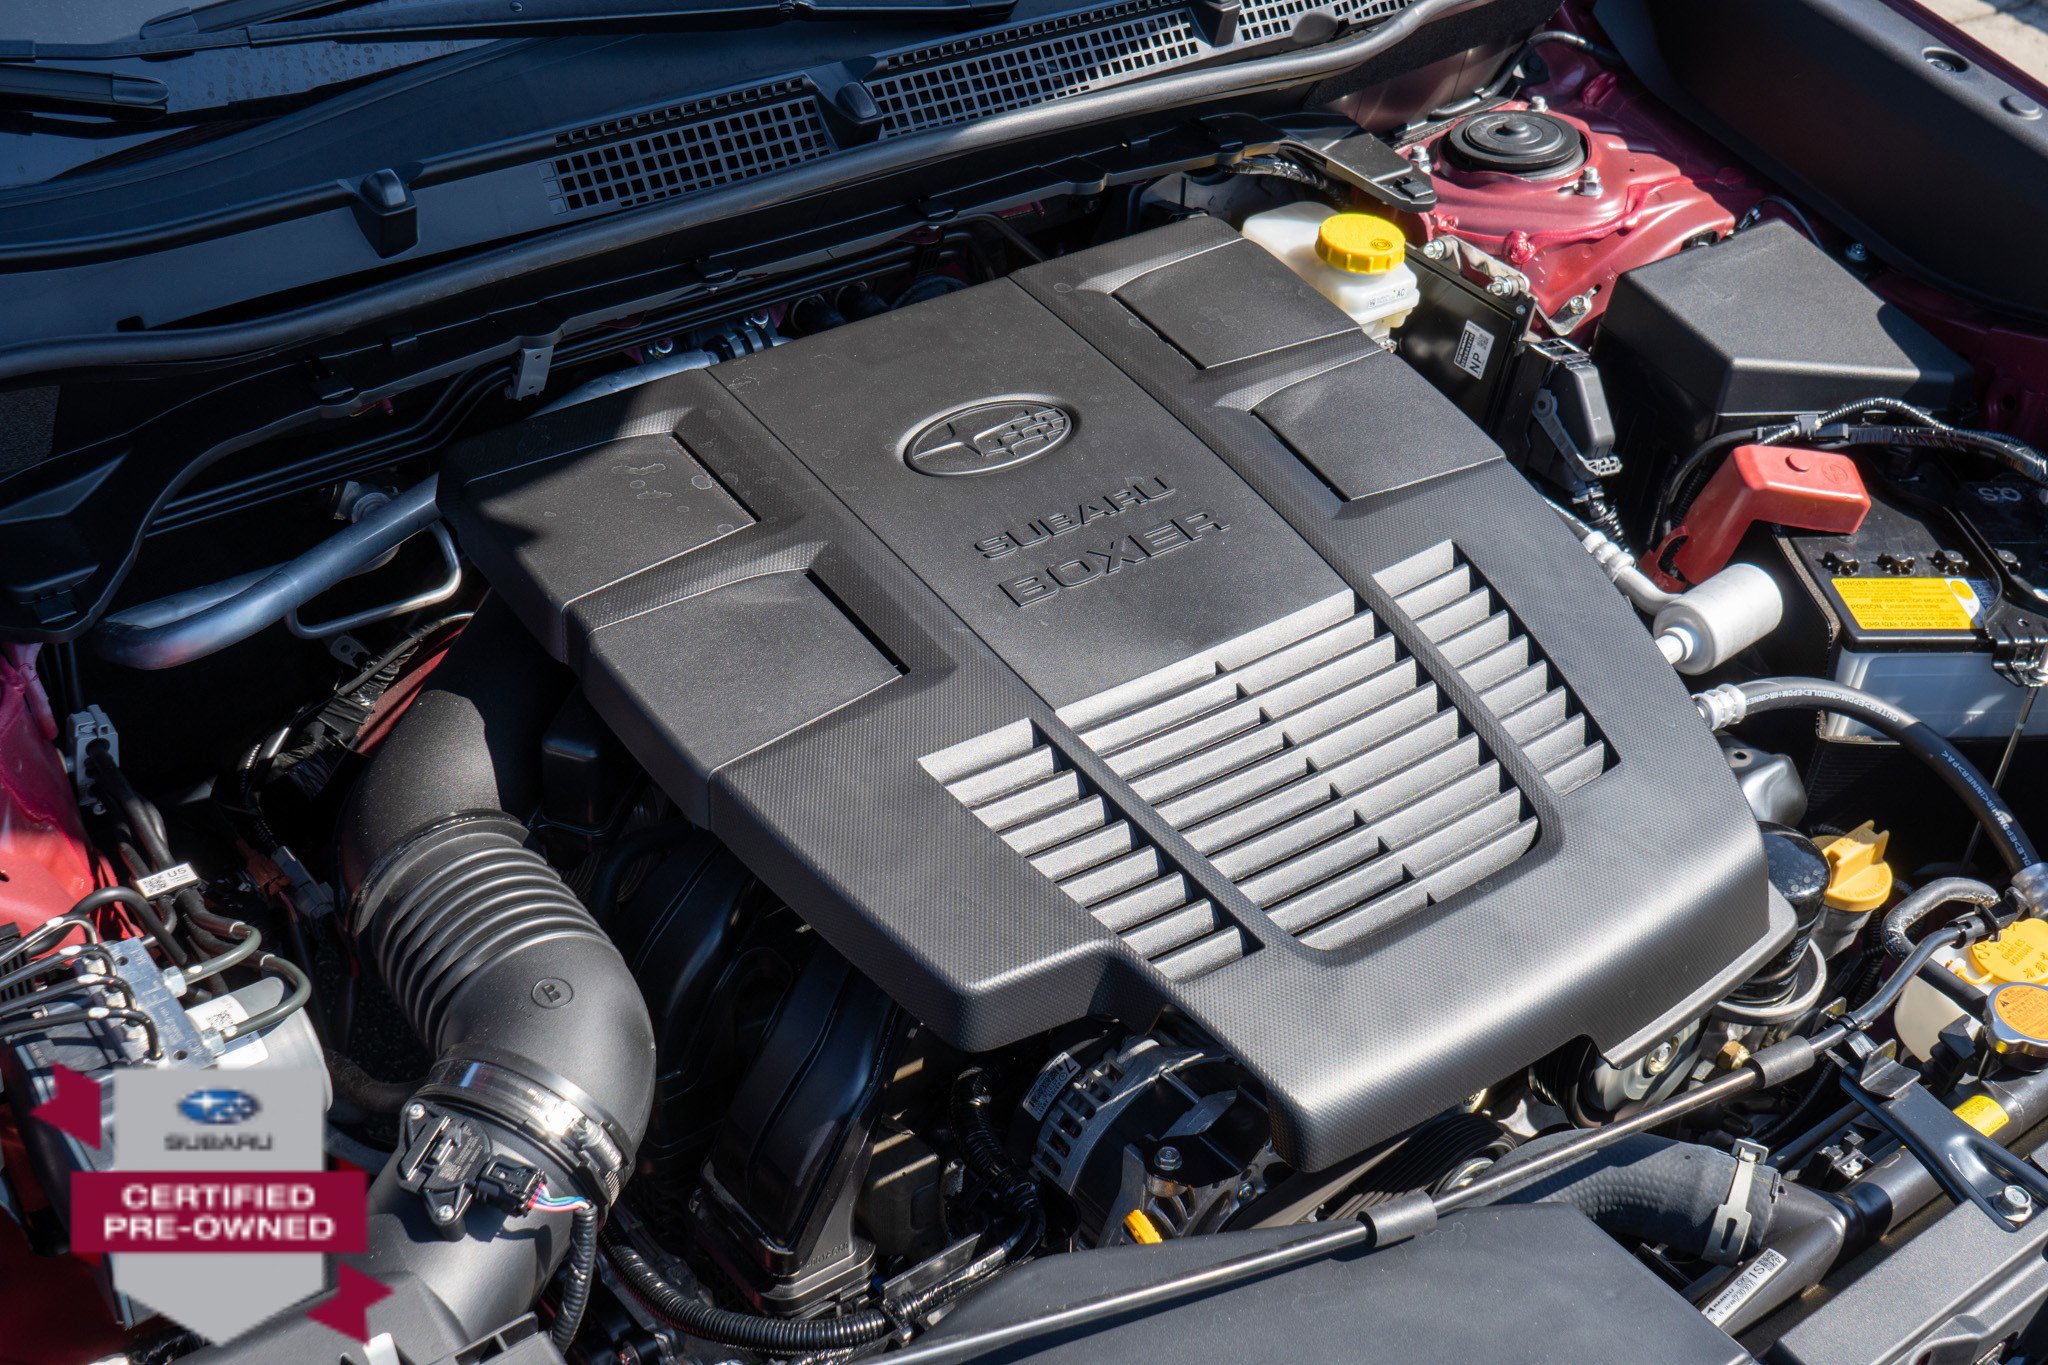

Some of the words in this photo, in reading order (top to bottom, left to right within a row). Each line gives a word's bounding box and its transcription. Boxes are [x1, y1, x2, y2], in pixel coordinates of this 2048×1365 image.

[1469, 352, 1483, 374] NP
[974, 476, 1175, 559] SUBARU
[997, 509, 1230, 607] BOXER
[541, 984, 561, 1002] B
